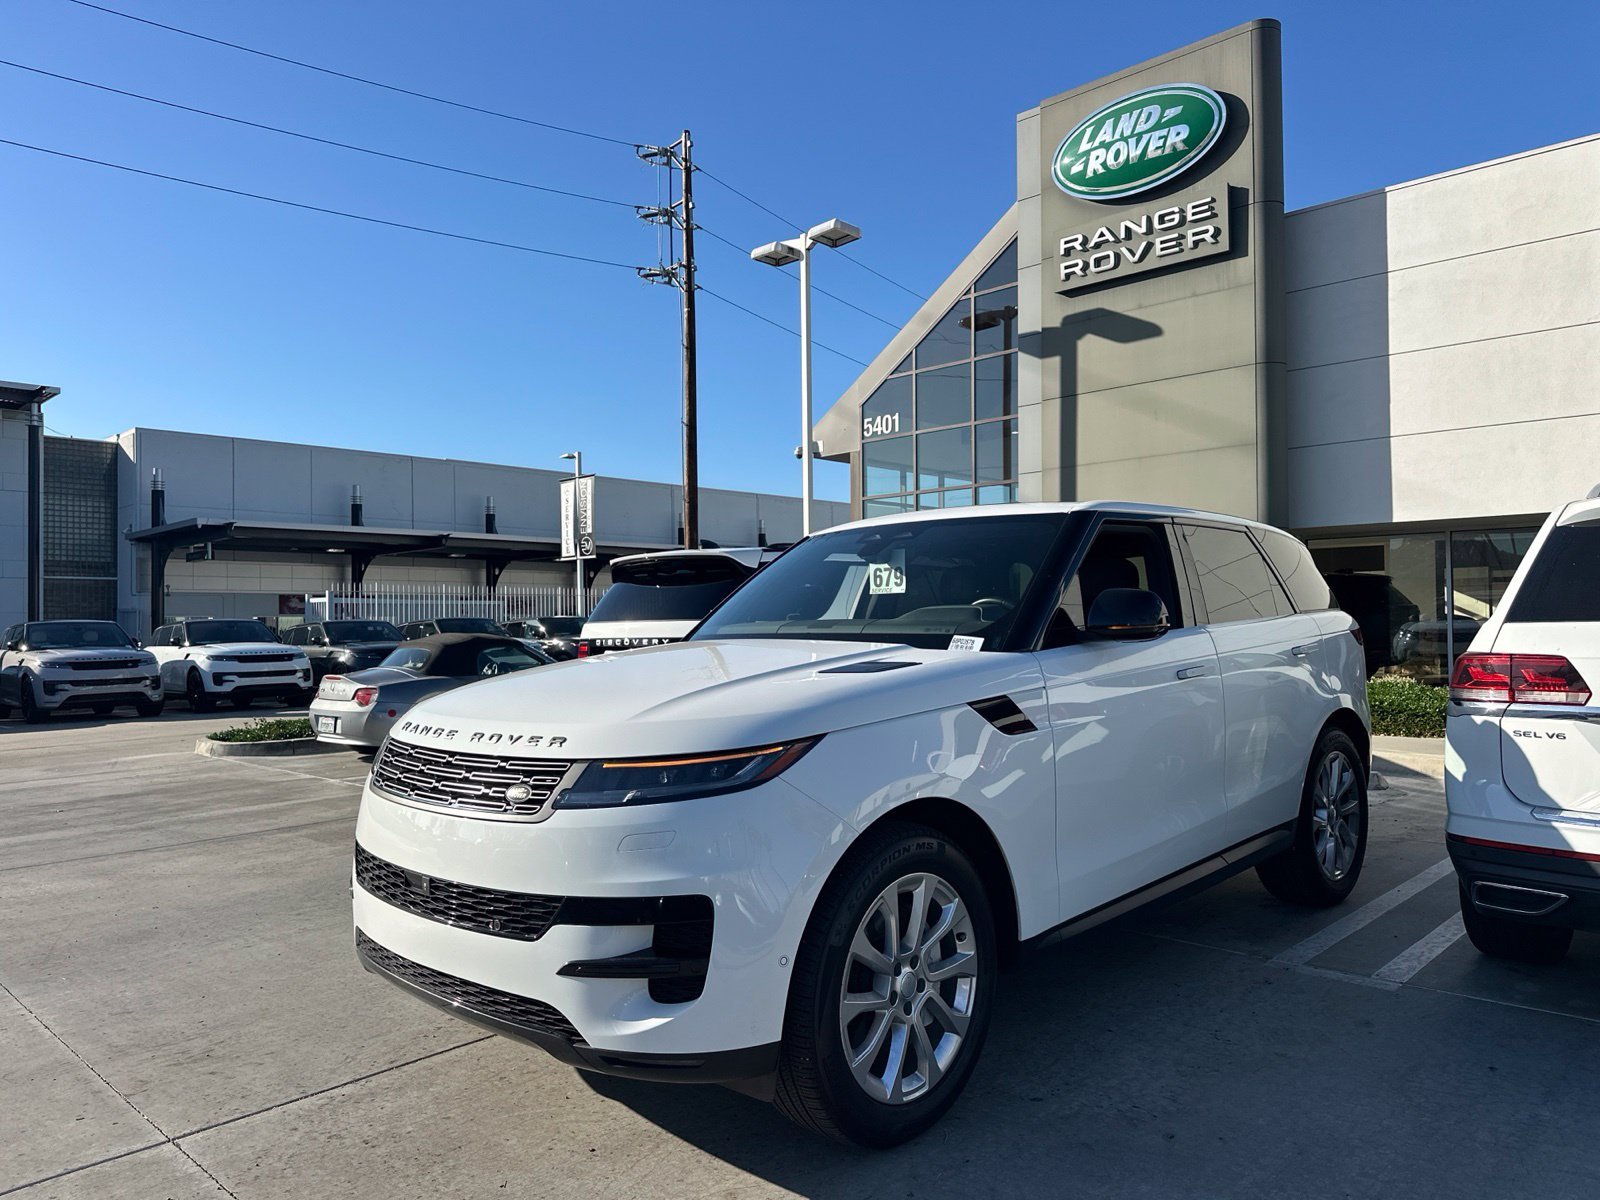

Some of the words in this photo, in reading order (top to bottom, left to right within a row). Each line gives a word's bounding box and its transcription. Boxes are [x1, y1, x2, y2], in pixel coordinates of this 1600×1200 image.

[1077, 104, 1162, 154] LAND
[1086, 124, 1191, 179] ROVER
[1059, 197, 1217, 257] RANGE
[1059, 225, 1220, 281] ROVER
[863, 412, 899, 437] 5401
[580, 480, 588, 534] ENVISION
[873, 566, 904, 588] 679
[595, 637, 670, 647] DISCOVERY
[401, 721, 459, 741] RANGE
[469, 732, 568, 748] ROVER
[1513, 730, 1542, 738] SEL
[1545, 732, 1567, 741] V6
[915, 841, 934, 851] MS
